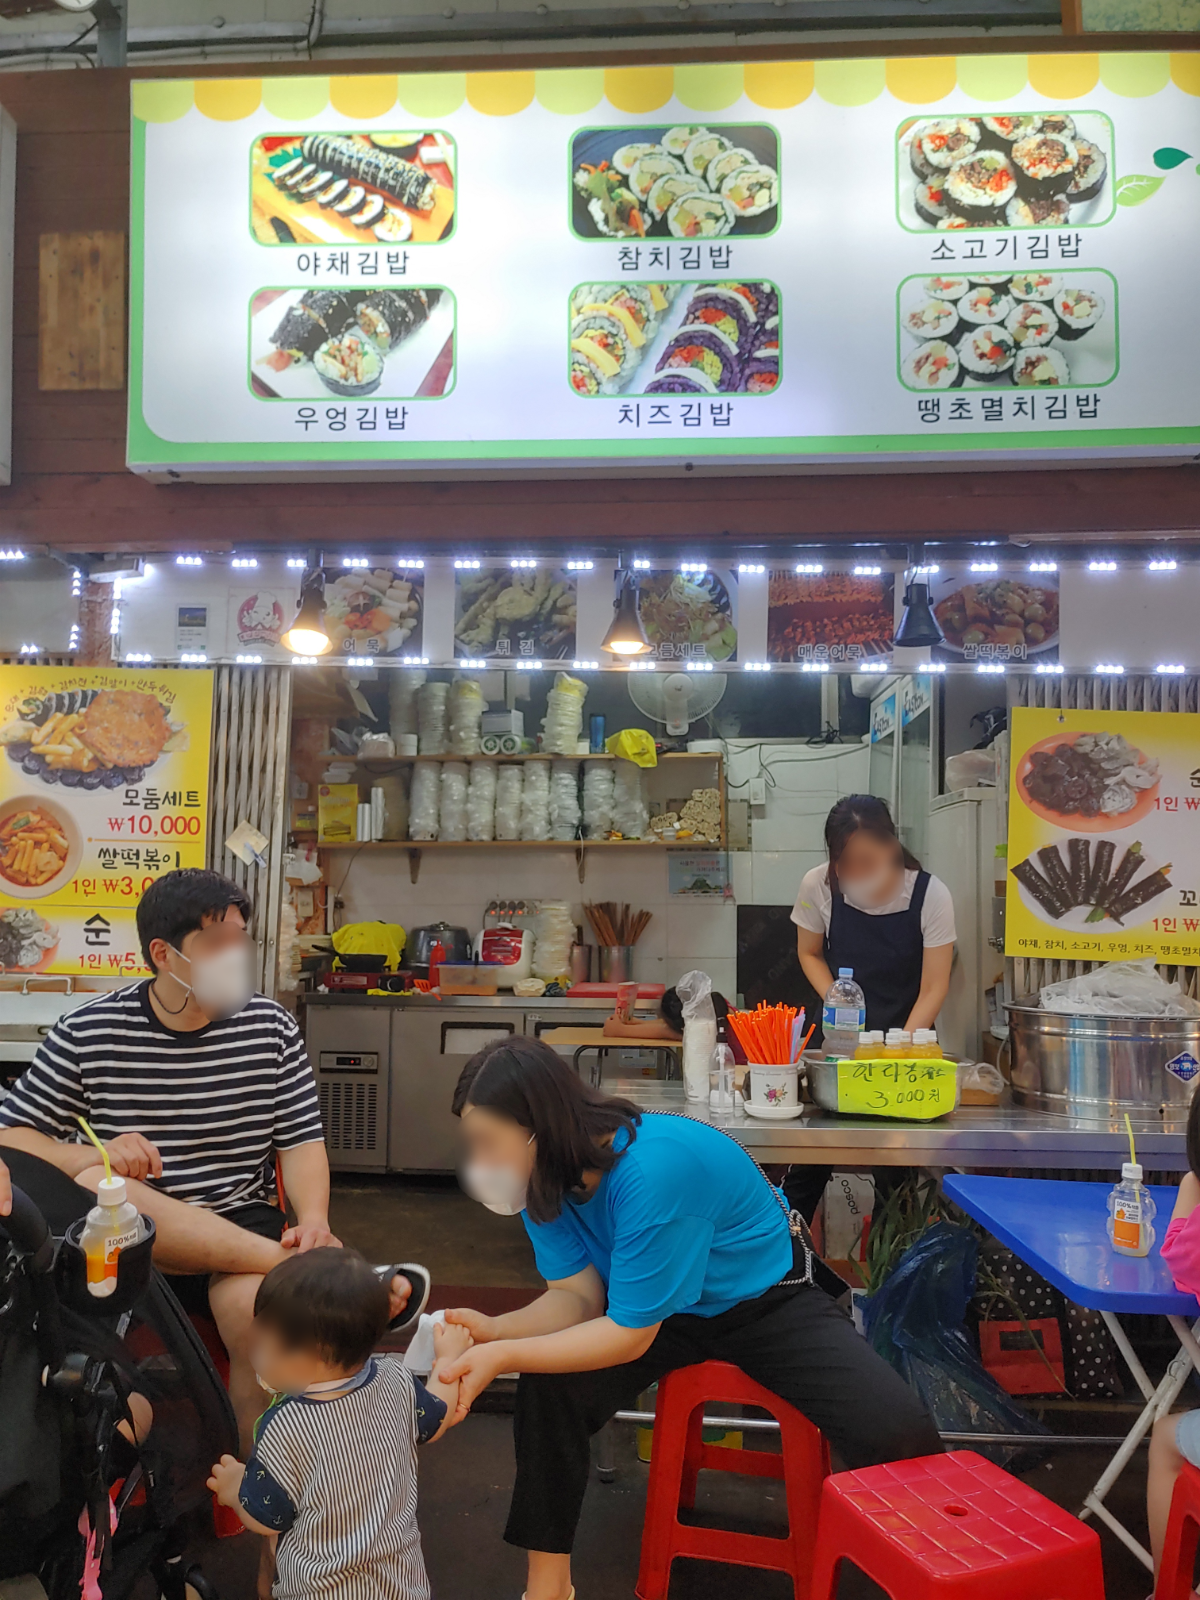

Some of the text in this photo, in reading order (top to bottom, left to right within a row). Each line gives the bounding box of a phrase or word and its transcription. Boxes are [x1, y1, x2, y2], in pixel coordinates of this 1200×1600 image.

[931, 233, 1082, 261] 소고기김밥
[297, 250, 409, 277] 야채김밥
[617, 245, 733, 271] 참치김밥
[618, 402, 734, 428] 치즈김밥
[918, 394, 1101, 423] 땡초멸치김밥
[294, 406, 409, 432] 우엉김밥
[343, 638, 380, 653] 어묵
[496, 639, 535, 656] 튀김
[798, 644, 862, 660] 매운어묵
[963, 643, 1028, 660] 쌀떡볶이
[122, 788, 201, 810] 모둠세트
[1154, 796, 1179, 812] 1인
[107, 815, 201, 836] ₩10,000
[97, 848, 181, 871] 쌀떡볶이
[72, 879, 97, 895] 1인
[1179, 890, 1200, 906] 꼬
[83, 913, 111, 946] 순
[1152, 917, 1177, 933] 1인
[1018, 939, 1041, 949] 야채,
[1044, 940, 1067, 950] 참치,
[1071, 942, 1104, 952] 소고기,
[1107, 943, 1130, 953] 우엉,
[1133, 944, 1157, 955] 치즈,
[79, 954, 102, 969] 1인
[108, 1236, 130, 1247] 100%
